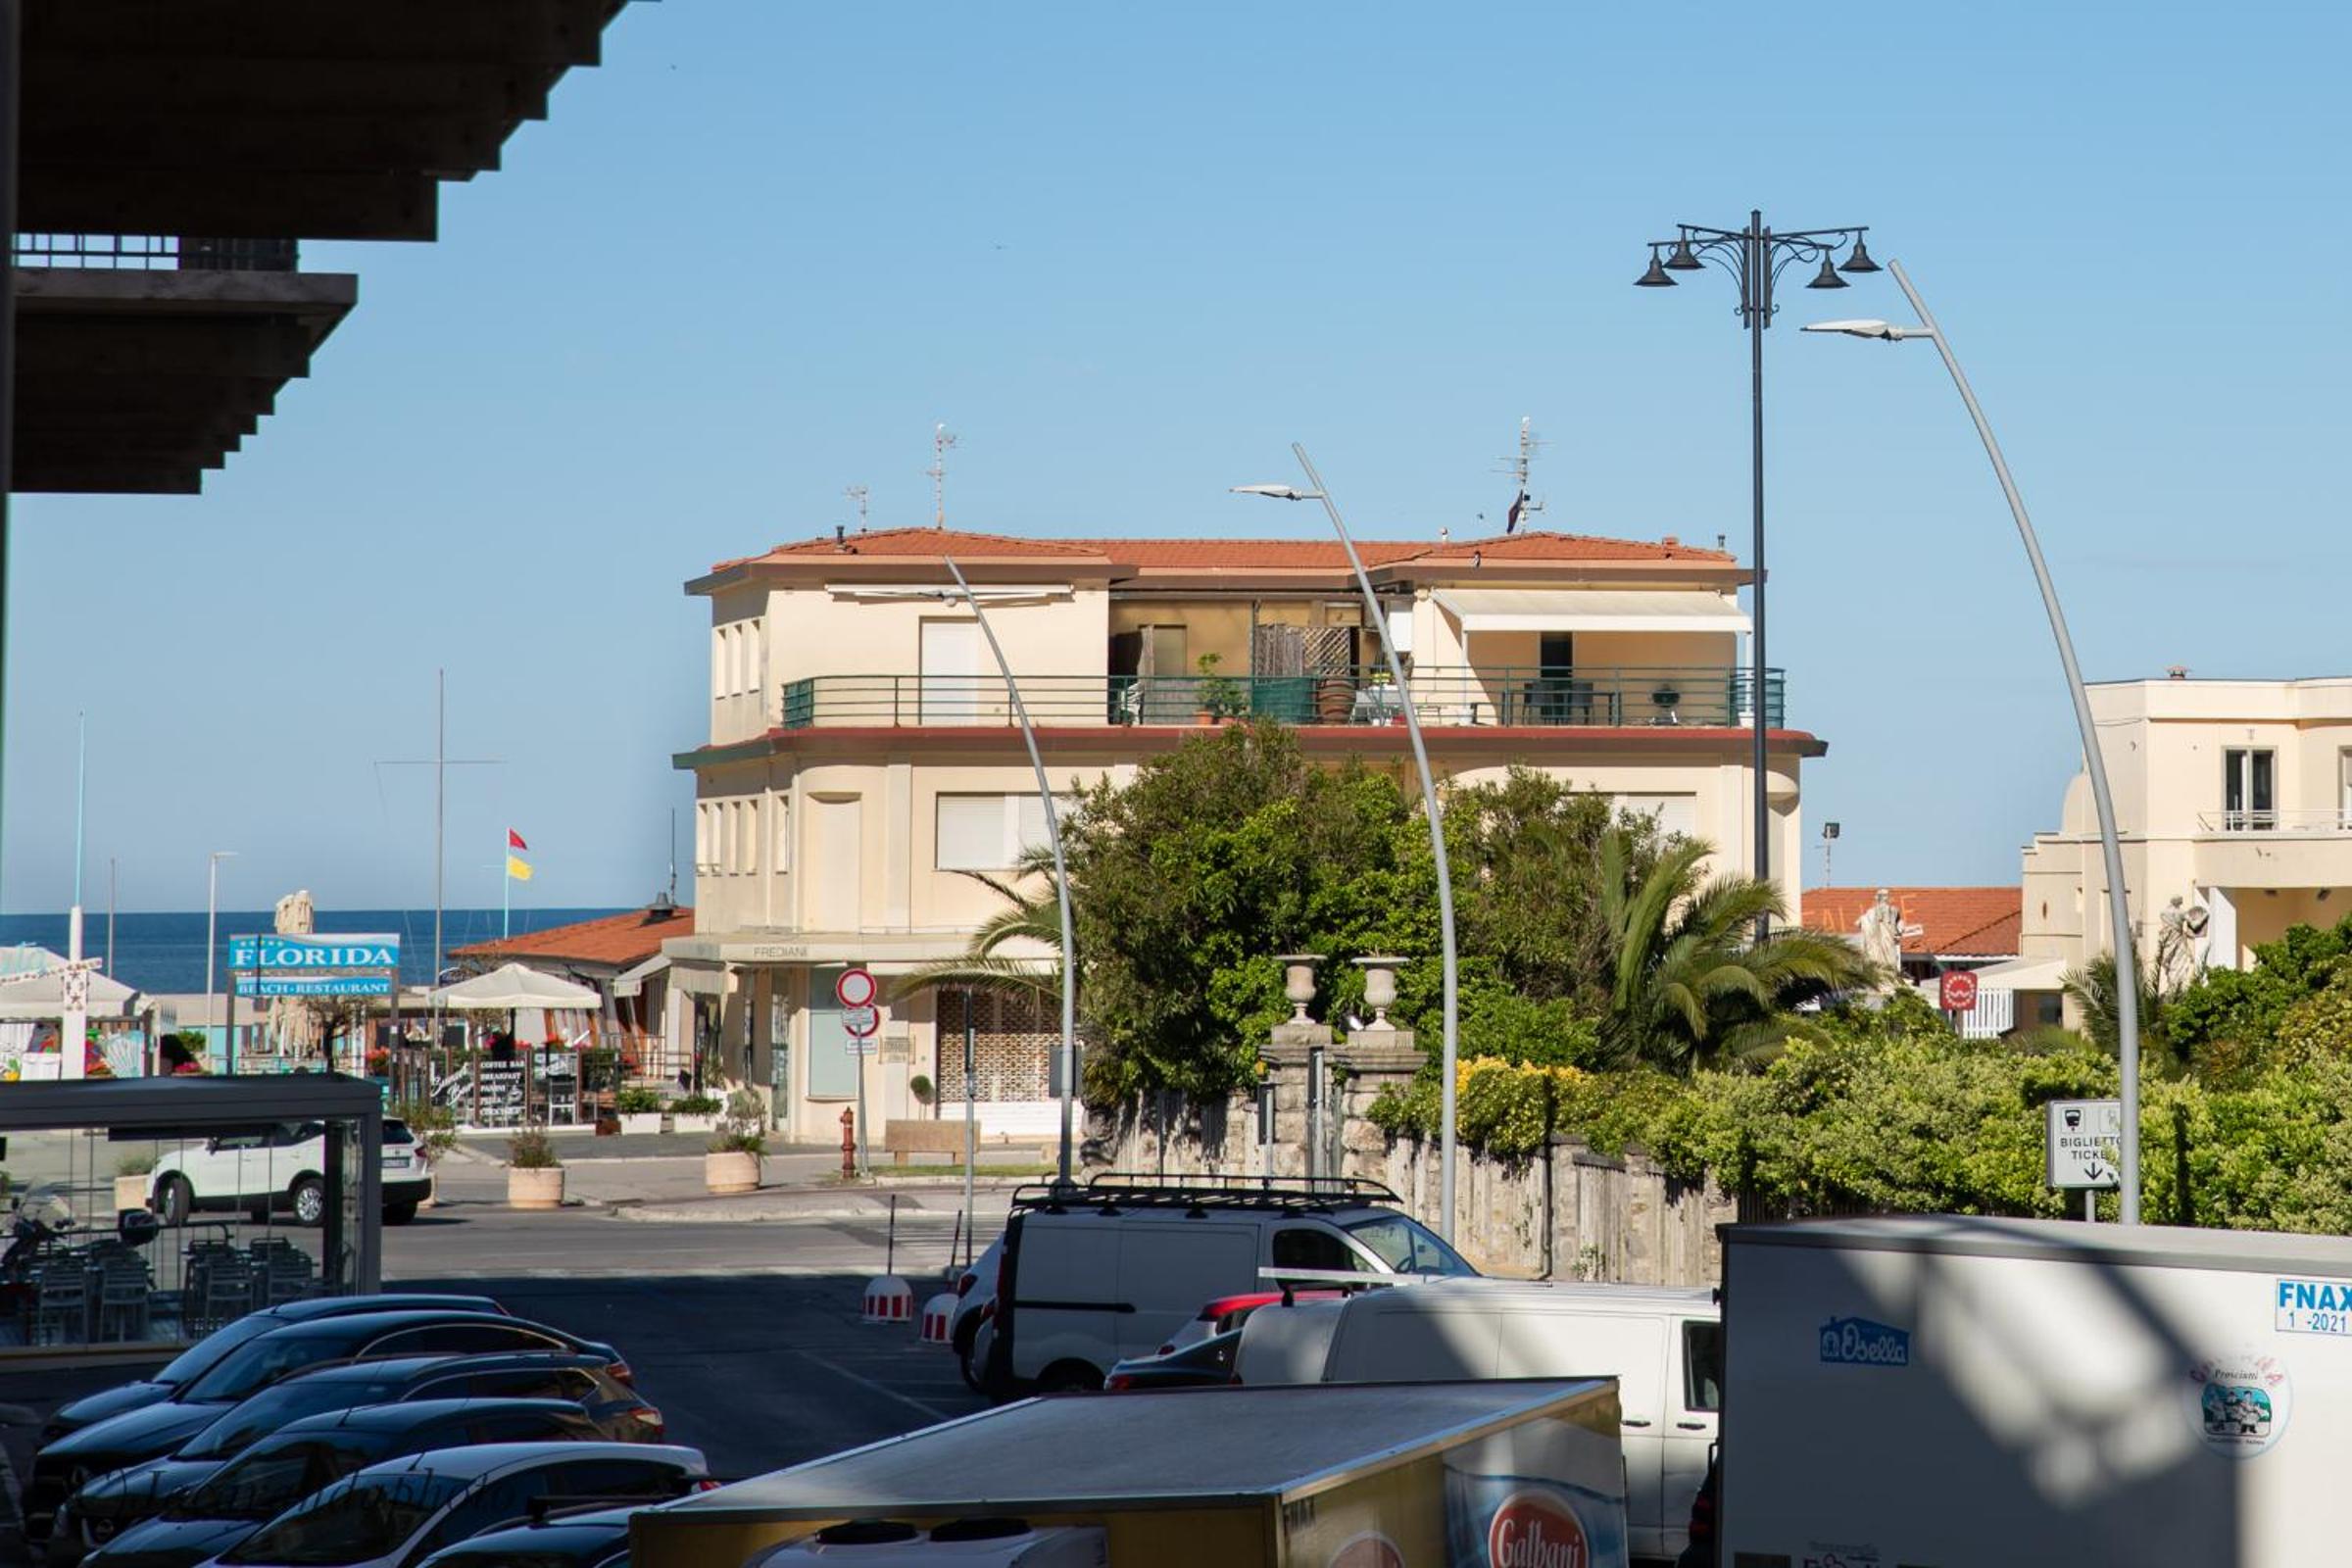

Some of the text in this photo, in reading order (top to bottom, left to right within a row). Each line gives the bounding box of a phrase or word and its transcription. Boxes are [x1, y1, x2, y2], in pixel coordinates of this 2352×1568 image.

[234, 948, 394, 966] FLORIDA
[238, 983, 388, 994] BEACH RESTAURANT
[480, 1060, 507, 1069] COFFEE
[480, 1072, 521, 1081] BREAKFAST
[2060, 1137, 2121, 1148] BIGLIET
[2071, 1151, 2106, 1160] TICKE
[2278, 1282, 2352, 1311] FNAX
[1841, 1323, 1906, 1363] Osella
[2214, 1368, 2259, 1380] Prosciutti
[1496, 1518, 1581, 1568] Galbani
